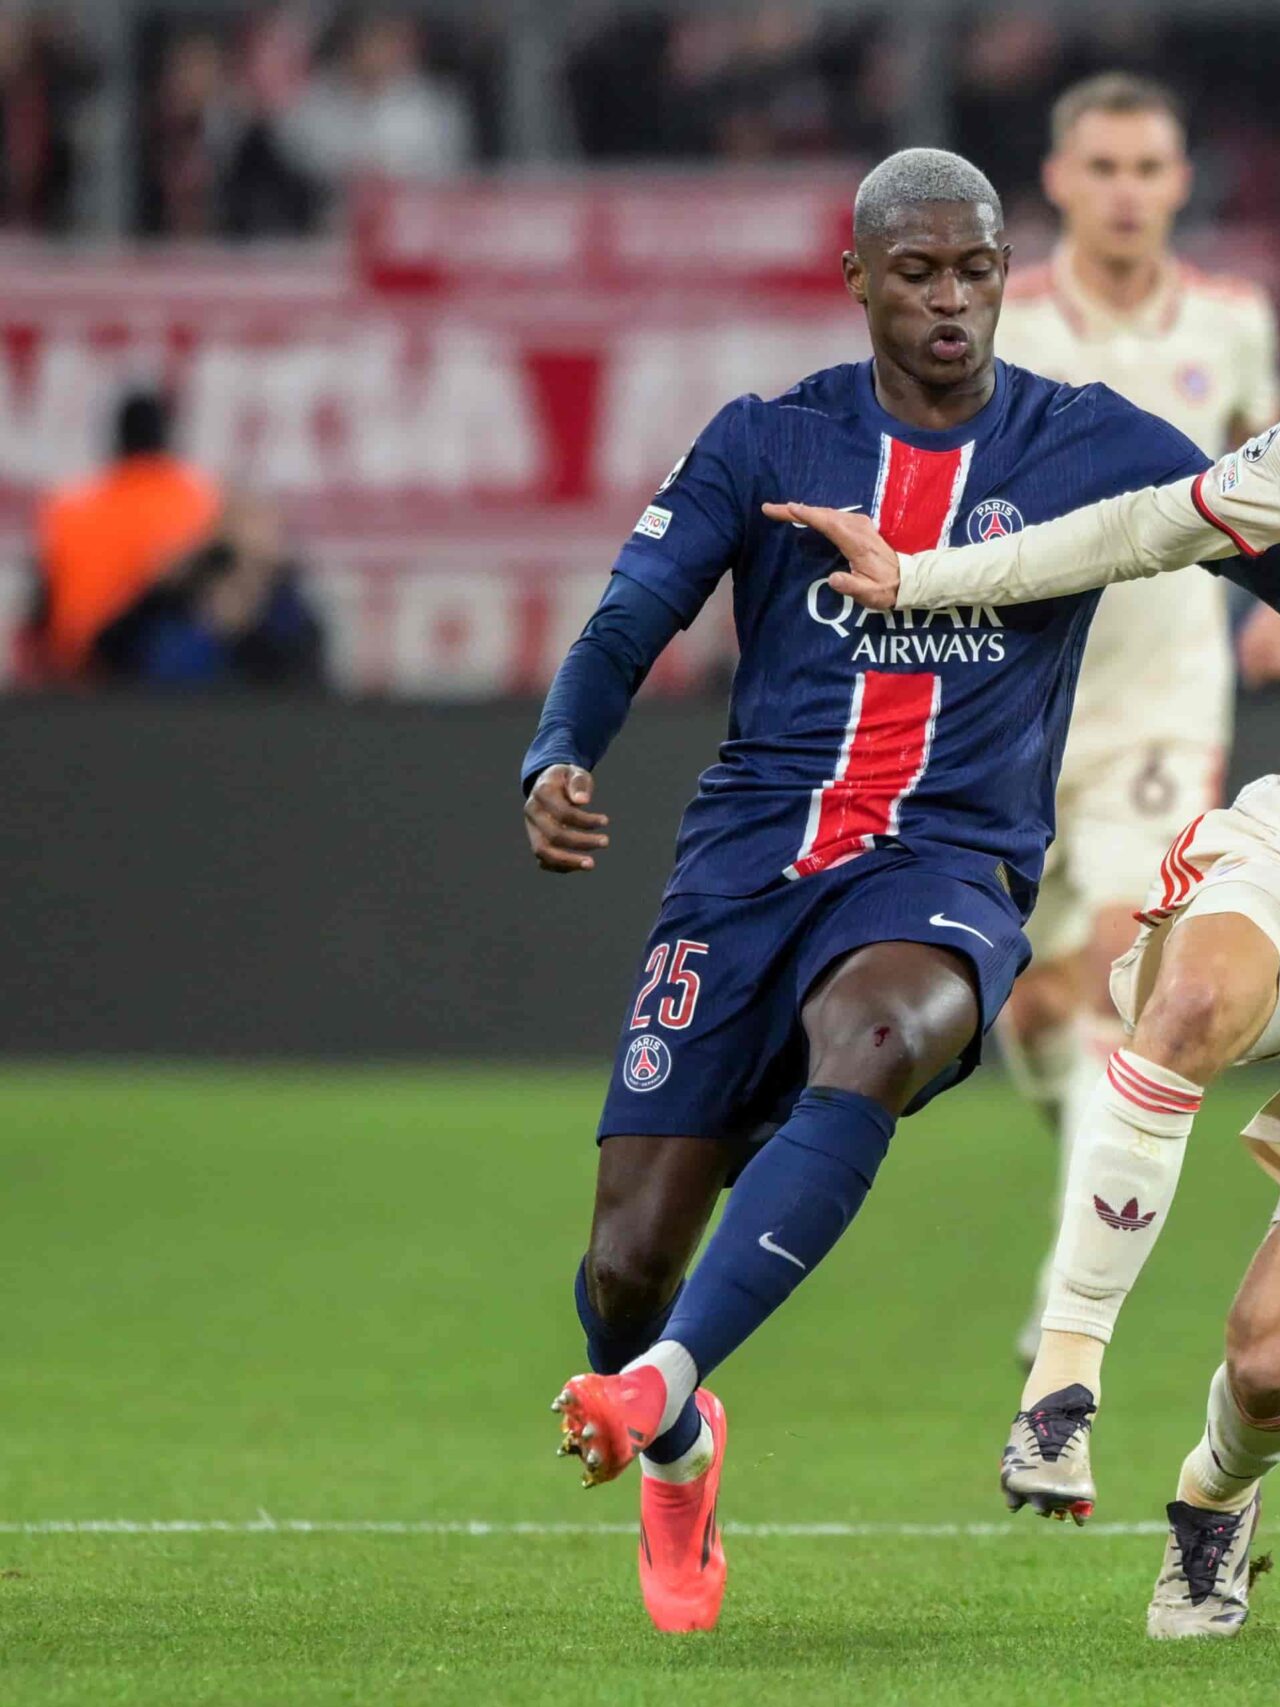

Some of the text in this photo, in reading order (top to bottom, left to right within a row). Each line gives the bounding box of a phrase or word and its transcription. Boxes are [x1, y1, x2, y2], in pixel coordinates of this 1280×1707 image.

[976, 502, 1014, 516] PARIS
[851, 633, 1006, 664] AIRWAYS
[1130, 748, 1178, 818] 6
[630, 939, 710, 1030] 25
[630, 1037, 662, 1053] PARIS
